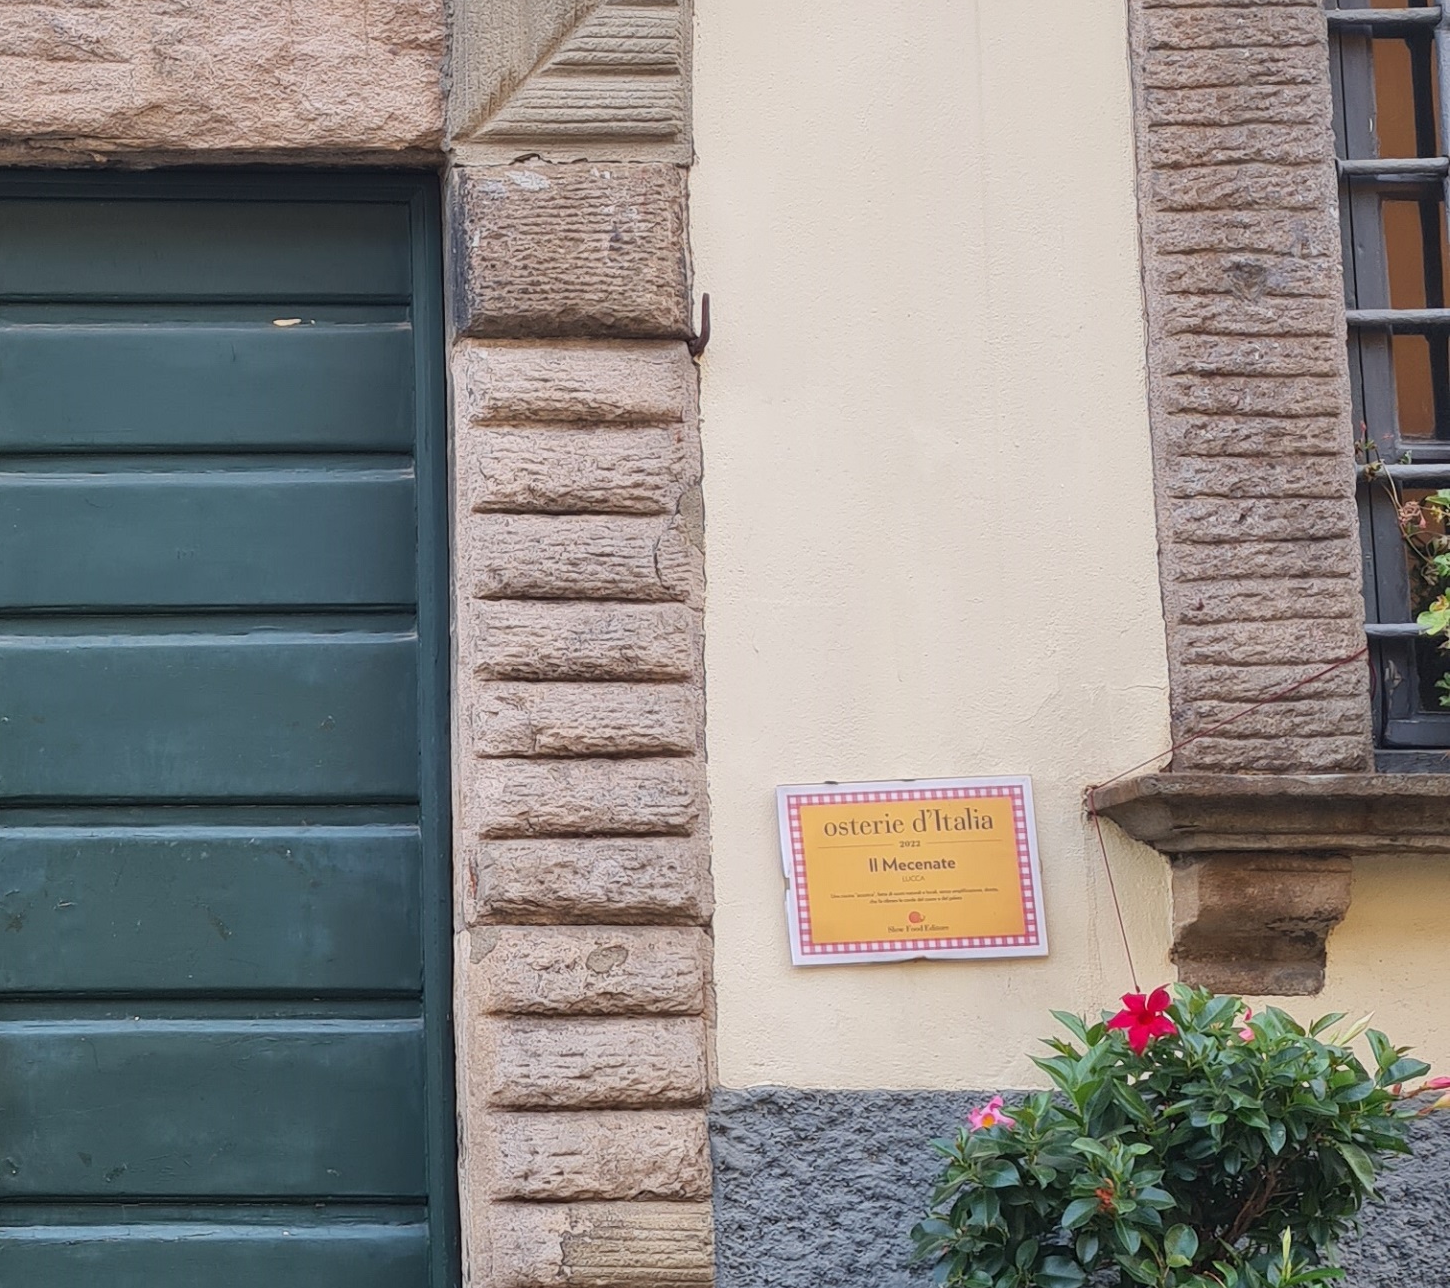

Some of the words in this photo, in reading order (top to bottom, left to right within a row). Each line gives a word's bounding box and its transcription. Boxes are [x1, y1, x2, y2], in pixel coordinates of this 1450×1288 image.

[824, 813, 904, 837] osterie
[899, 840, 921, 848] 2022
[869, 858, 878, 873] Il
[882, 858, 956, 872] Mecenate
